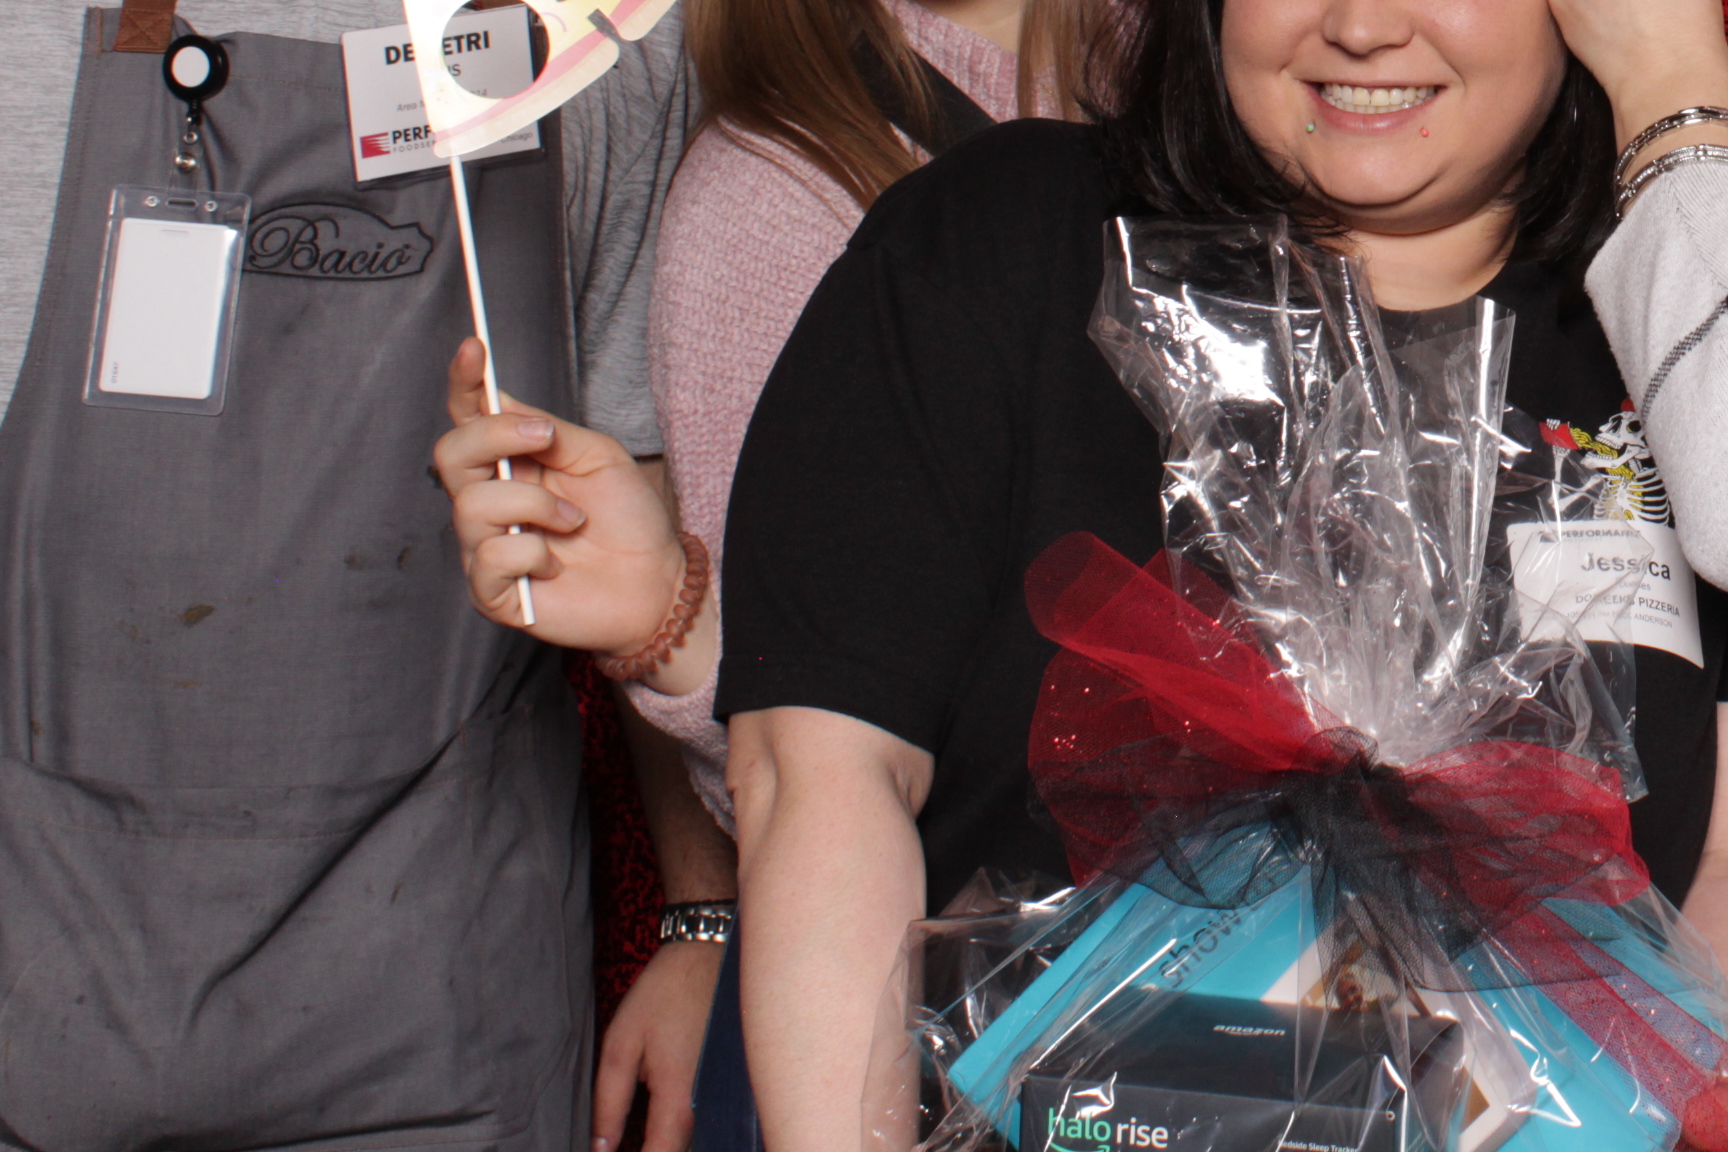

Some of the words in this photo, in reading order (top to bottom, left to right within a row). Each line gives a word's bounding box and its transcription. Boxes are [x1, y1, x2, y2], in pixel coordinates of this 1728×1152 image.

[384, 30, 490, 65] DEETRI
[250, 215, 412, 275] Bacio
[1634, 613, 1673, 628] ANDERSON
[1638, 597, 1680, 617] PIZZERIA
[1213, 1025, 1286, 1036] amazon
[1047, 1107, 1111, 1141] halo
[1116, 1117, 1168, 1148] rise
